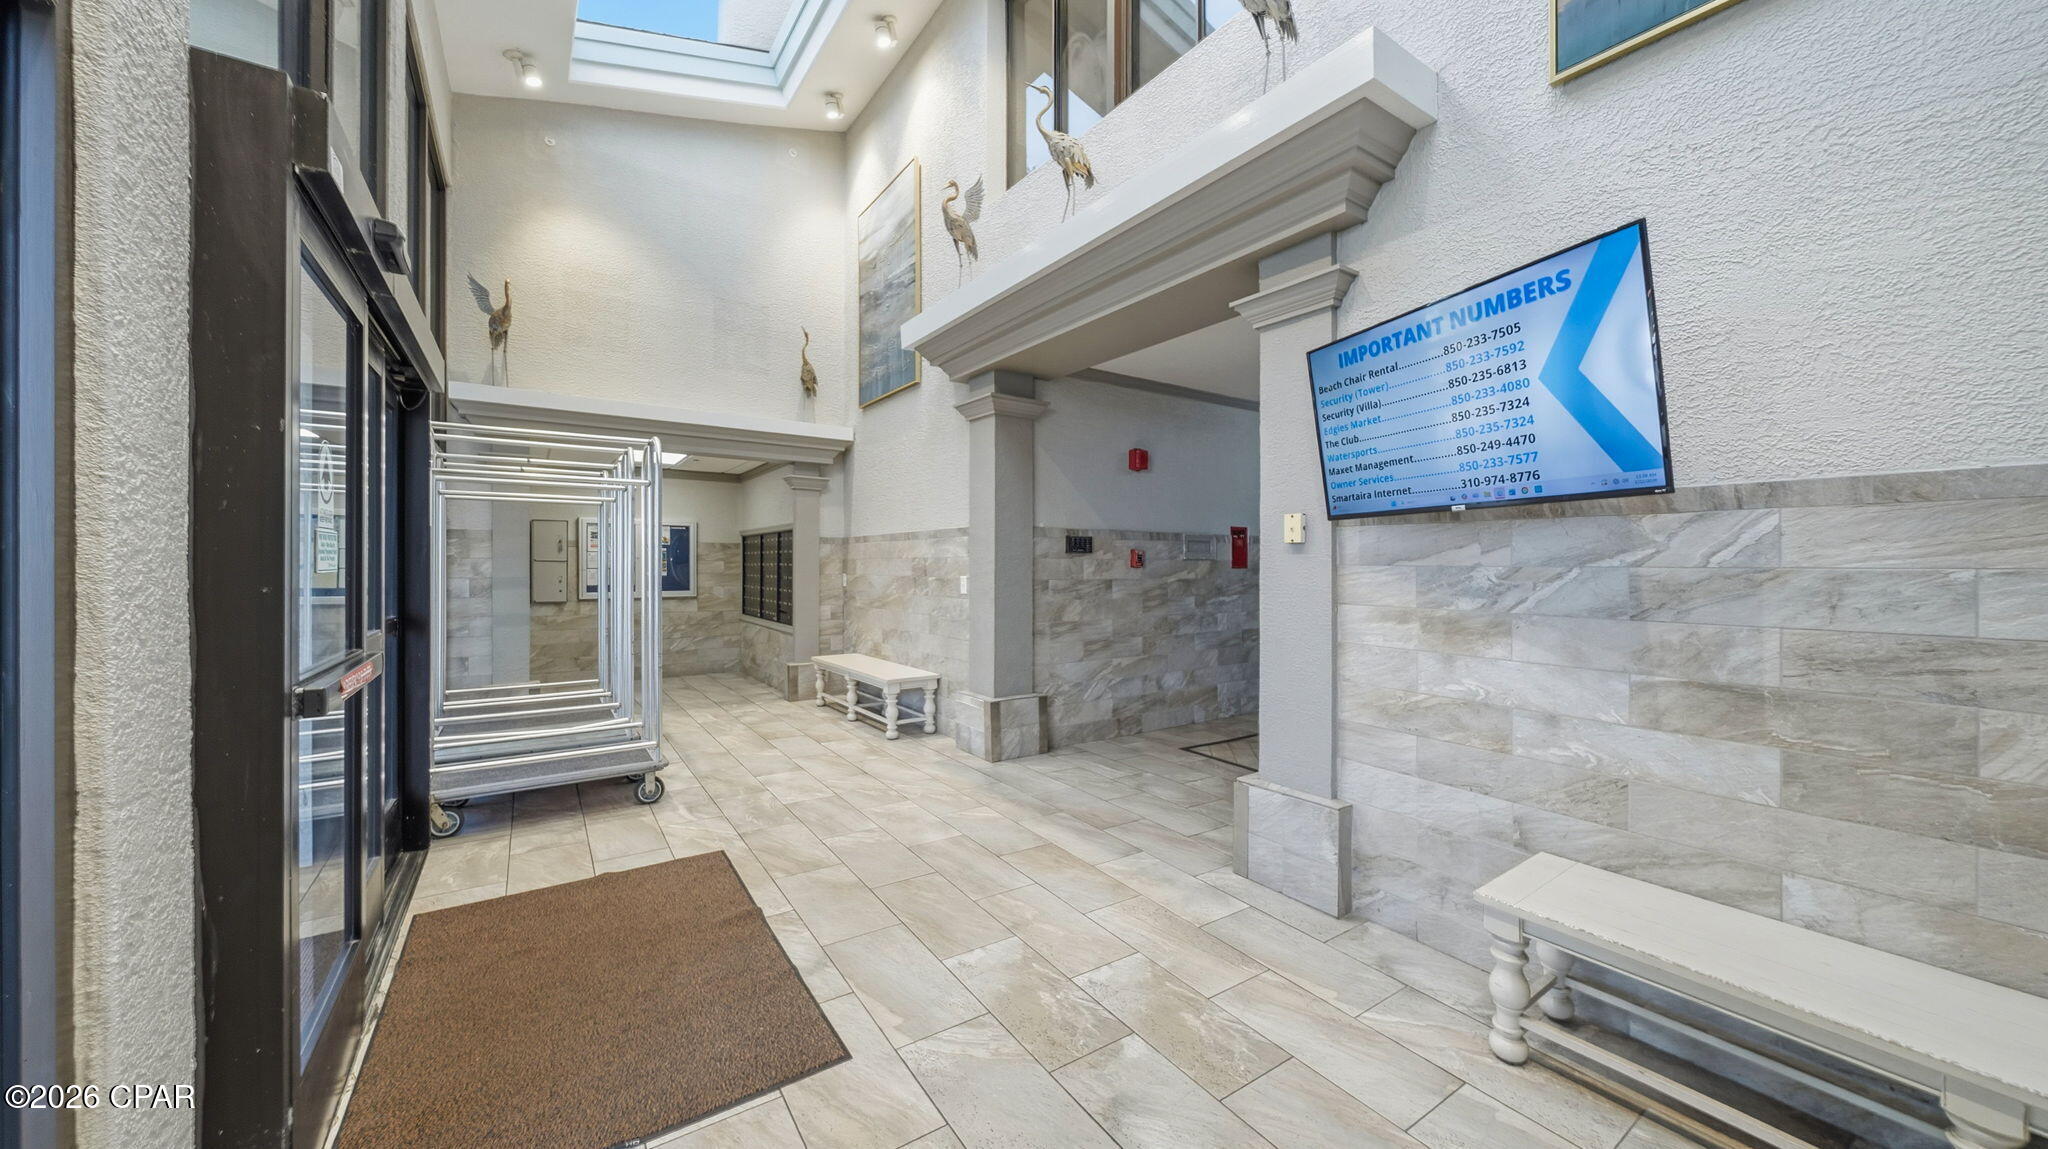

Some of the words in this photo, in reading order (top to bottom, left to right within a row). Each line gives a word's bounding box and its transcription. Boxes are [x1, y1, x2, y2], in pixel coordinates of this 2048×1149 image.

[1338, 316, 1444, 369] IMPORTANT
[1449, 268, 1572, 330] NUMBERS
[1319, 381, 1343, 395] Beach
[1344, 373, 1366, 387] Chair
[1443, 322, 1521, 355] 850-233-7505
[1320, 393, 1353, 408] Security
[1445, 340, 1525, 372] 850-233-7592
[1322, 406, 1354, 422] Security
[1448, 359, 1527, 389] 850-235-6813
[1324, 422, 1348, 436] Edgies
[1451, 377, 1530, 405] 850-233-4080
[1325, 440, 1340, 449] The
[1451, 396, 1530, 422] 850-235-7324
[1455, 414, 1535, 439] 850-235-7324
[1329, 464, 1353, 476] Maxet
[1457, 433, 1536, 456] 850-249-4470
[1331, 479, 1356, 490] Owner
[1459, 451, 1538, 472] 850-233-7577
[1332, 491, 1372, 504] Smartaira
[1461, 469, 1541, 489] 310-974-8776
